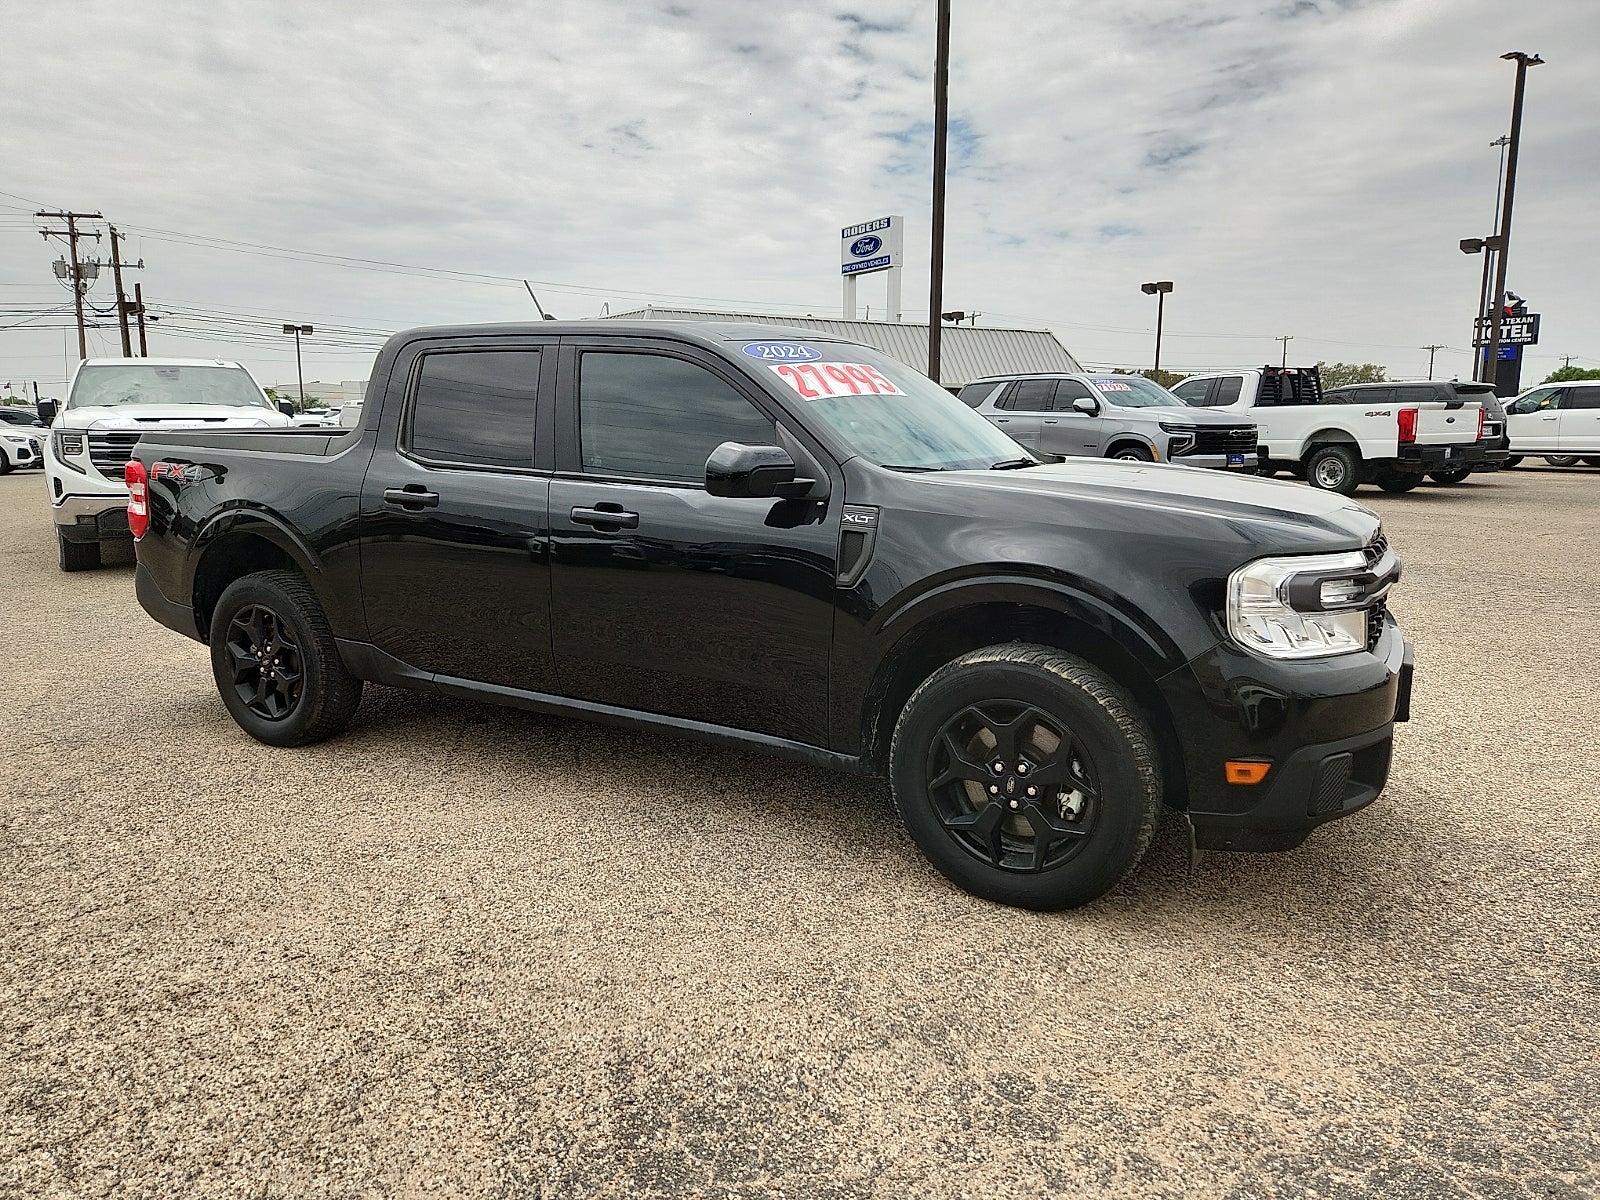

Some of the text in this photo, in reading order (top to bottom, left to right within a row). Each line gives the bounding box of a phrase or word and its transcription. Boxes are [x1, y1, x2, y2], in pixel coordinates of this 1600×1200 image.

[843, 218, 888, 238] ROGERS
[855, 238, 875, 254] Ford
[842, 257, 889, 272] PRE-OWNED VEHICLES
[1506, 316, 1534, 324] TEXAN
[757, 344, 813, 359] 2024
[778, 364, 898, 397] 27995
[150, 461, 203, 481] FX4
[842, 513, 875, 523] XLT
